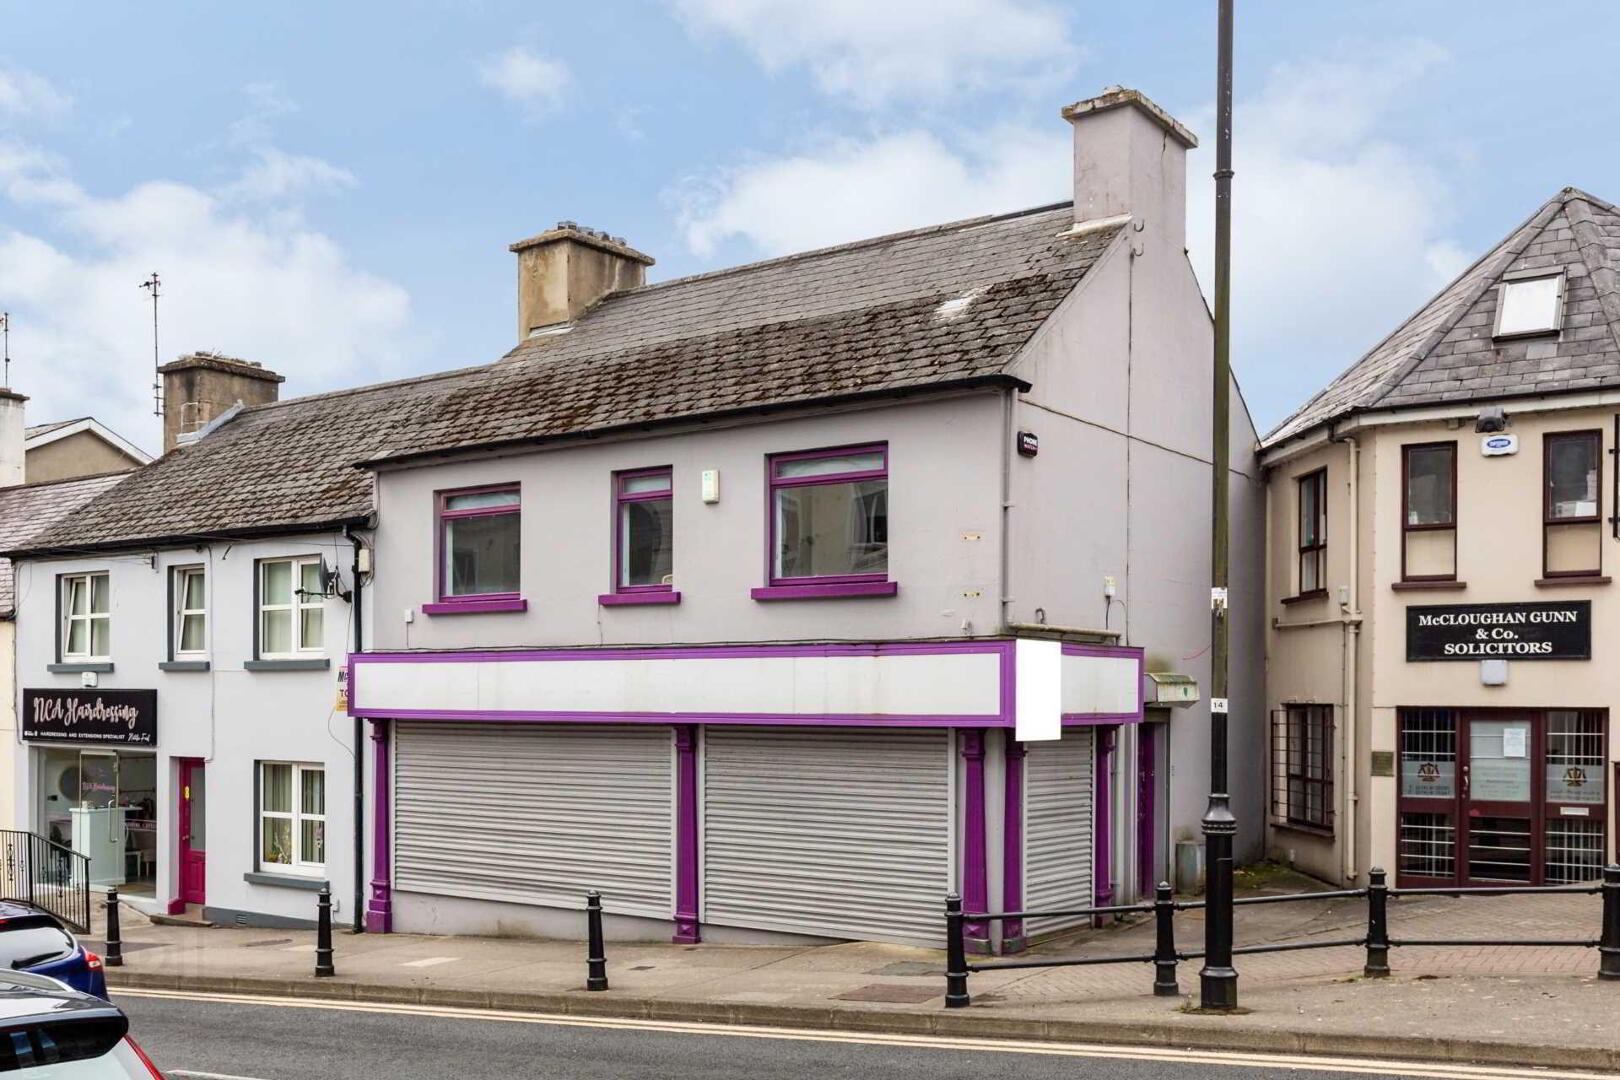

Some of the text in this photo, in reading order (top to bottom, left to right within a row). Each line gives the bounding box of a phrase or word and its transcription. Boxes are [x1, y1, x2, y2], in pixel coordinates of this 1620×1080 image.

[1024, 436, 1038, 446] PHONE
[1418, 611, 1578, 626] McCLOUGHAN GUNN
[1475, 628, 1519, 640] & Co.
[1444, 642, 1553, 655] SOLICITORS
[33, 697, 139, 729] NCA Hairdressing
